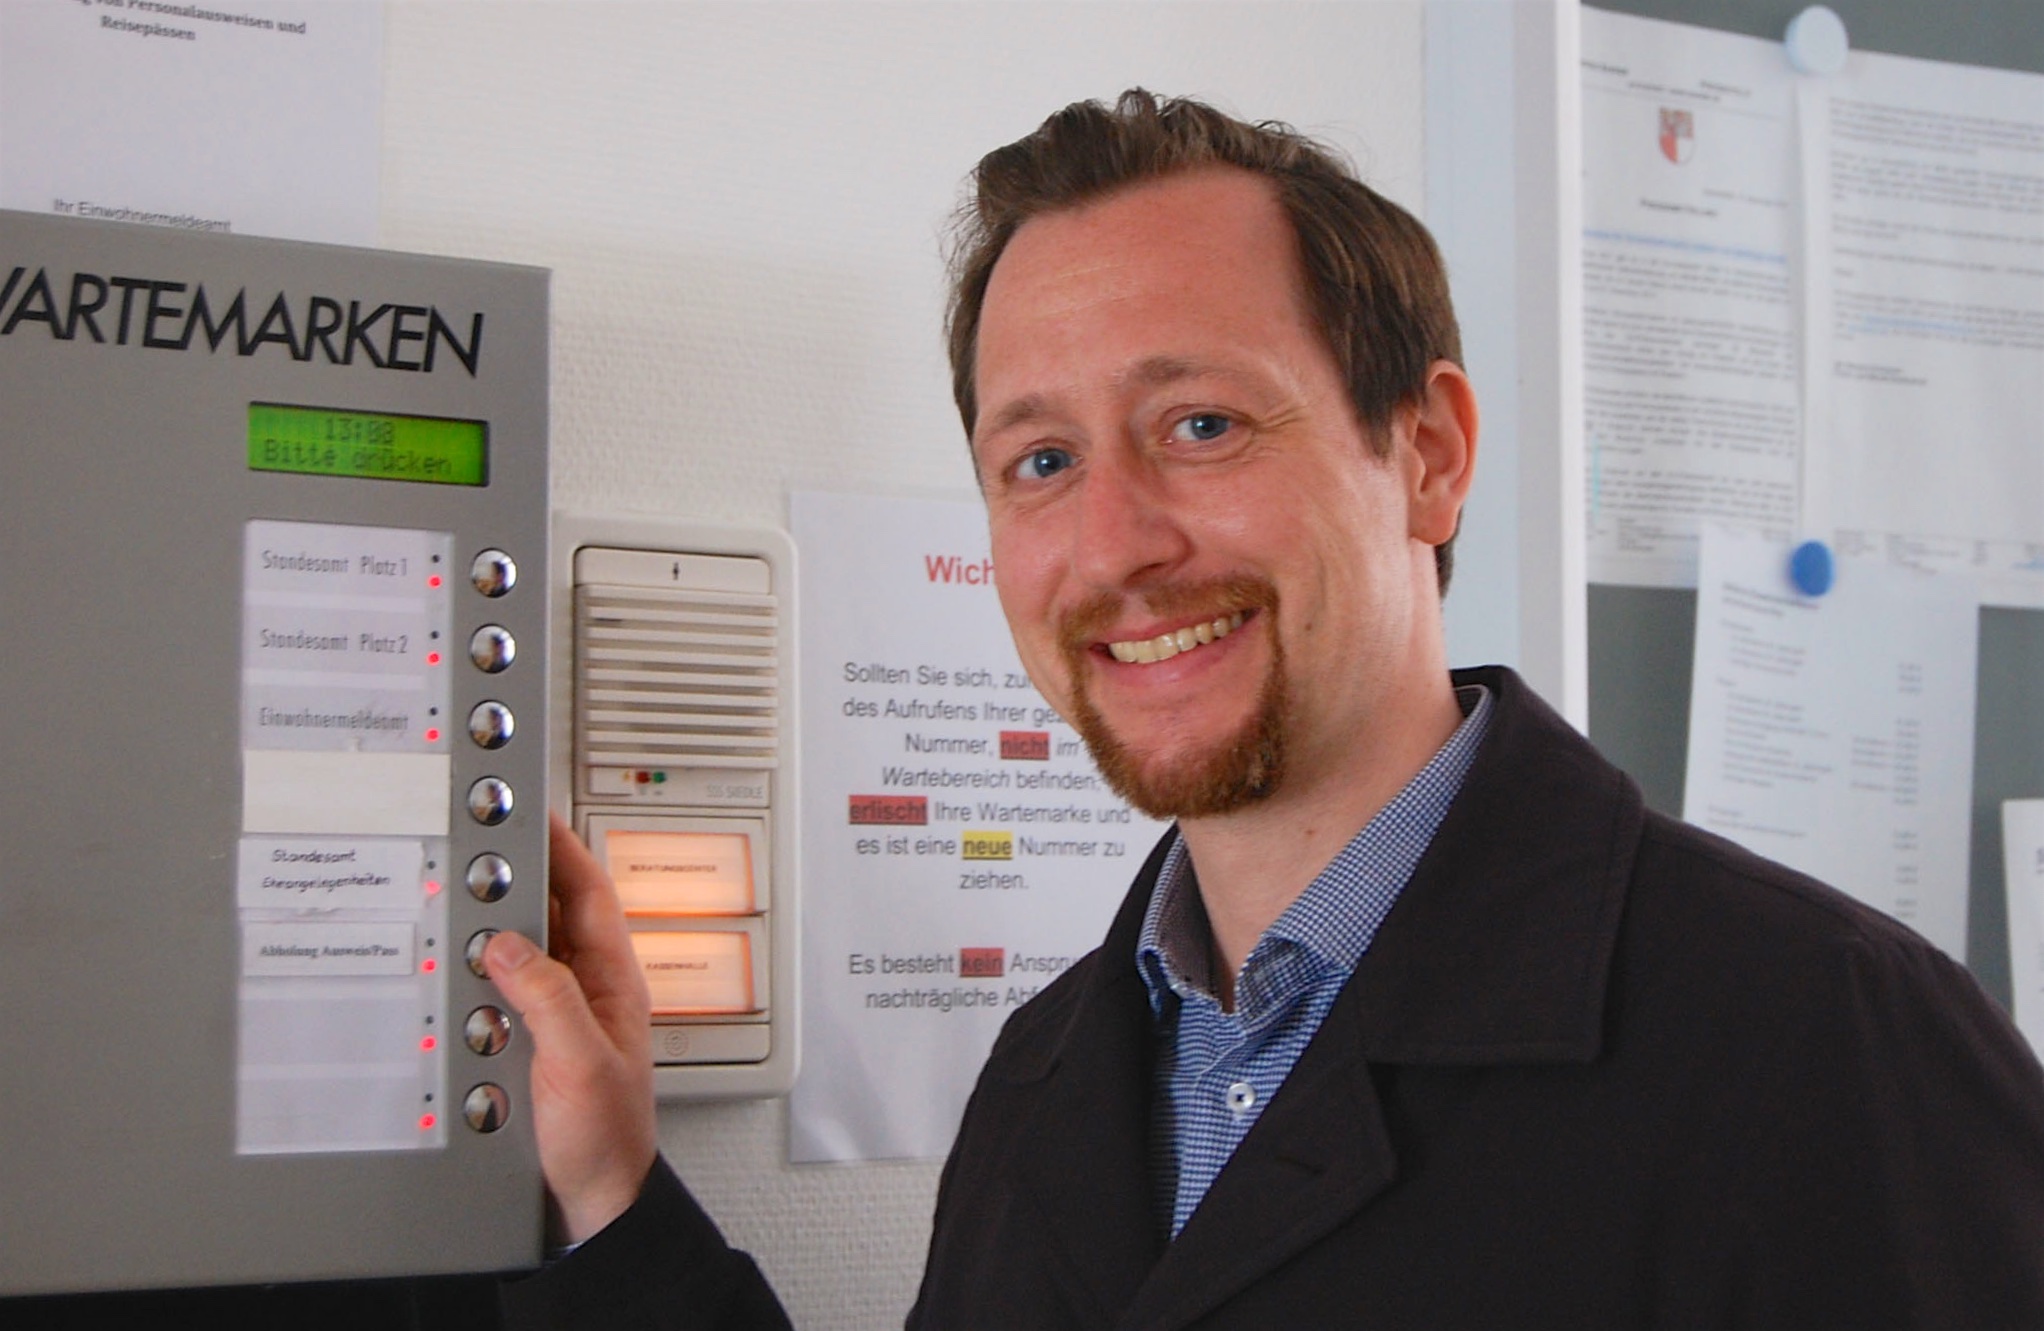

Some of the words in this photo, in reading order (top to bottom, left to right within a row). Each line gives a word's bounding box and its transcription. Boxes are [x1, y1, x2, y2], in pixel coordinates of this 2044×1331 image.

[101, 15, 196, 41] Reisepässen
[276, 21, 307, 35] und
[263, 438, 338, 469] Bitte
[262, 551, 349, 574] Standesamt
[360, 556, 398, 576] Platz
[261, 629, 349, 650] Standesamt
[360, 633, 396, 653] Platz
[398, 635, 408, 653] 2
[843, 662, 910, 685] Sollten
[917, 665, 948, 686] Sie
[954, 668, 998, 689] sich,
[259, 707, 409, 731] Einwohnermeldeamt
[843, 697, 879, 718] des
[884, 699, 977, 721] Aufrufens
[983, 703, 1027, 722] Ihrer
[905, 733, 995, 758] Nummer,
[1000, 737, 1049, 756] nicht
[1055, 739, 1080, 757] im
[882, 767, 1010, 788] Wartebereich
[849, 800, 927, 819] erlischt
[934, 801, 972, 820] Ihre
[978, 803, 1092, 822] Wartemarke
[1097, 805, 1131, 823] und
[856, 839, 880, 855] es
[886, 837, 909, 855] ist
[914, 839, 956, 856] eine
[963, 840, 1012, 859] neue
[1018, 837, 1098, 857] Nummer
[1103, 841, 1126, 857] zu
[959, 871, 1029, 890] ziehen.
[849, 954, 876, 974] Es
[881, 954, 954, 974] besteht
[960, 955, 1003, 974] kein
[866, 986, 999, 1012] nachträgliche
